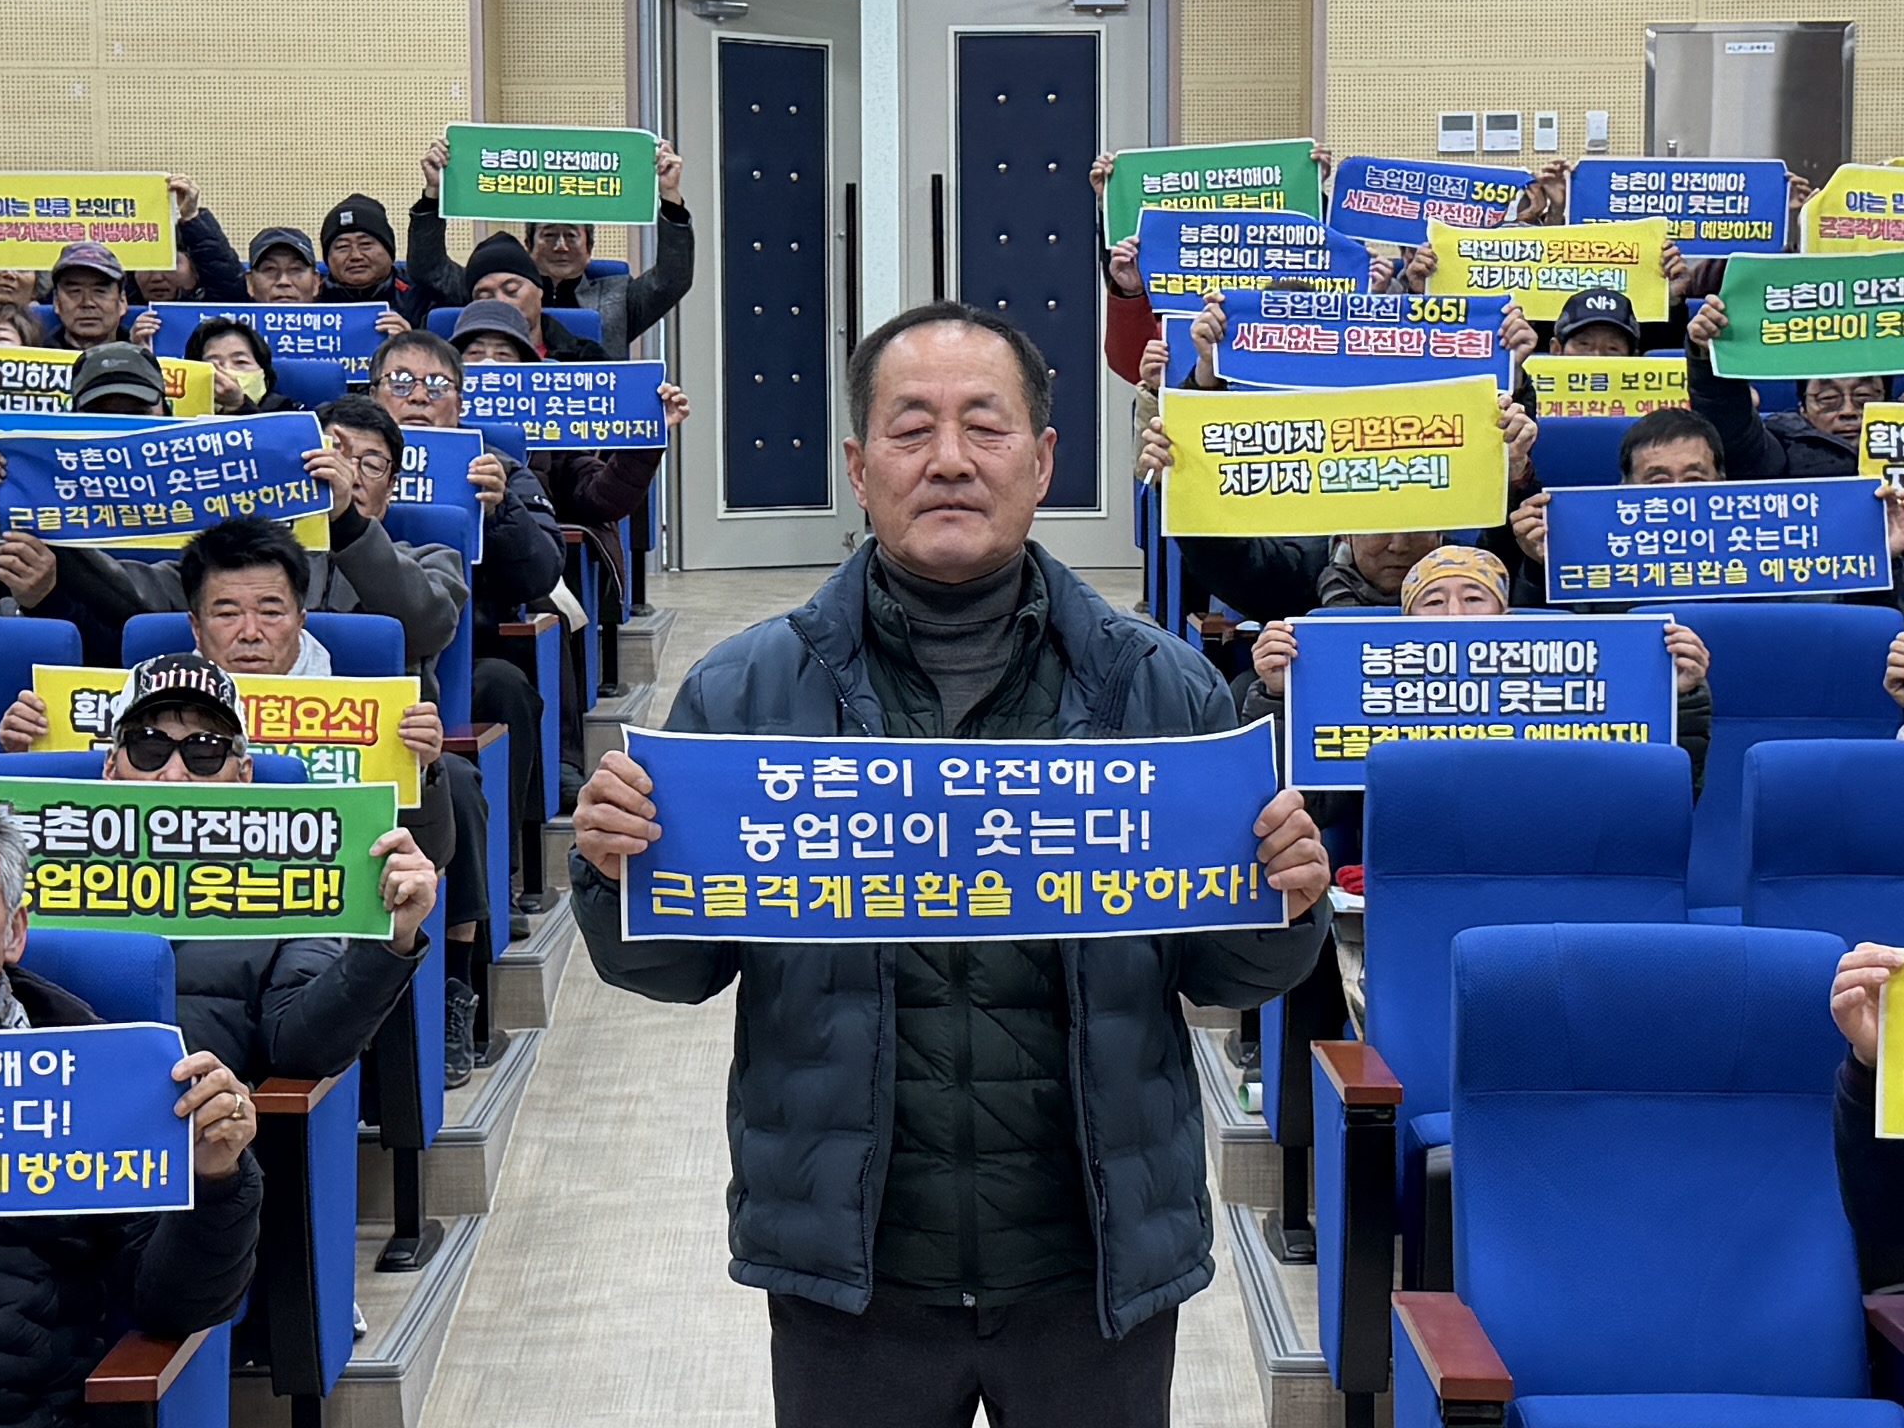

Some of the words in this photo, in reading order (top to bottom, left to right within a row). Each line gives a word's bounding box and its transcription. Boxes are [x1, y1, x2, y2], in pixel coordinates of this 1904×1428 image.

[481, 148, 538, 170] 농촌이
[543, 149, 620, 172] 안전해야
[477, 173, 553, 196] 농업인이
[559, 175, 622, 197] 웃는다!
[1142, 173, 1199, 194] 농촌이
[1470, 180, 1517, 203] 365!
[1609, 171, 1666, 192] 농촌이
[1670, 173, 1746, 193] 안전해야
[76, 196, 136, 218] 보인다!
[1179, 222, 1239, 245] 농촌이
[1458, 238, 1544, 264] 확인하자
[1546, 240, 1639, 265] 위험요소!
[1467, 264, 1533, 290] 지키자
[1764, 276, 1846, 311] 농촌이
[1260, 290, 1341, 321] 농업인
[1346, 294, 1401, 322] 안전
[1406, 296, 1467, 323] 365!
[1232, 322, 1339, 354] 사고없는
[1344, 326, 1425, 356] 안전한
[1430, 328, 1493, 358] 농촌!
[532, 371, 617, 393] 안전해야
[1567, 372, 1610, 391] 만큼
[544, 396, 616, 417] 웃는다!
[570, 419, 659, 441] 예방하자!
[1201, 419, 1325, 456] 확인하자
[1330, 414, 1465, 450] 위험요소!
[55, 445, 131, 472] 농촌이
[141, 428, 254, 468] 안전해야
[1218, 459, 1312, 496] 지키자
[1318, 454, 1450, 492] 안전수칙!
[8, 502, 195, 531] 근골격계질환을
[205, 479, 320, 517] 예방하자!
[1615, 497, 1698, 525] 농촌이
[1707, 491, 1821, 521] 안전해야
[1558, 559, 1750, 591] 근골격계질환을
[1759, 553, 1877, 583] 예방하자!
[1361, 639, 1457, 676] 농촌이
[1467, 639, 1599, 675] 안전해야
[756, 756, 915, 802] 농촌이
[938, 756, 1157, 797] 안전해야
[148, 809, 339, 857] 안전해야
[738, 811, 950, 863] 농업인이
[973, 807, 1152, 858] 웃는다!
[187, 864, 343, 913] 웃는다!
[650, 868, 1014, 920] 근골격계질환을
[1035, 861, 1261, 916] 예방하자!
